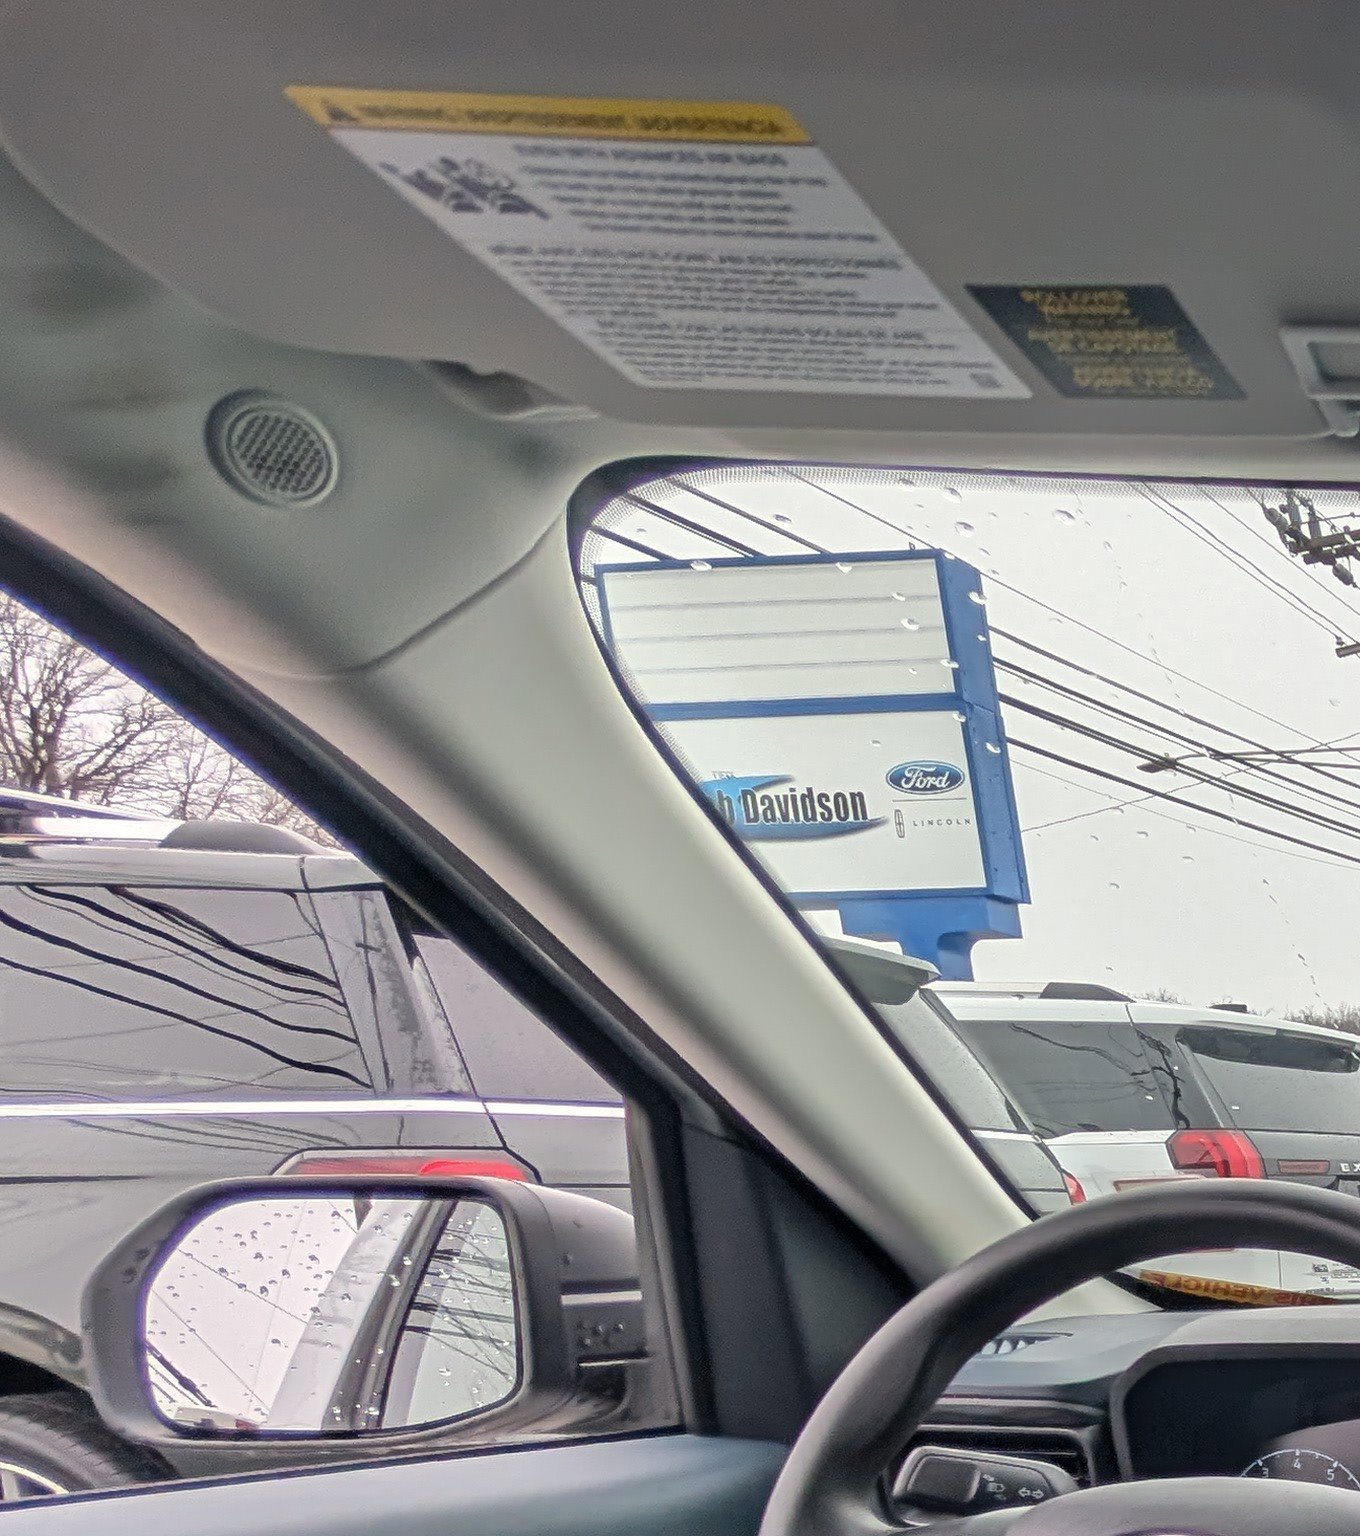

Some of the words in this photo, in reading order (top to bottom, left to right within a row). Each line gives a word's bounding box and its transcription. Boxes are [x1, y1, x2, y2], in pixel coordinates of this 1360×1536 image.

[741, 786, 868, 824] Davidson
[912, 818, 972, 828] LINCOLN
[1293, 1459, 1301, 1469] 4
[1262, 1467, 1269, 1478] 3
[1327, 1469, 1335, 1481] 5
